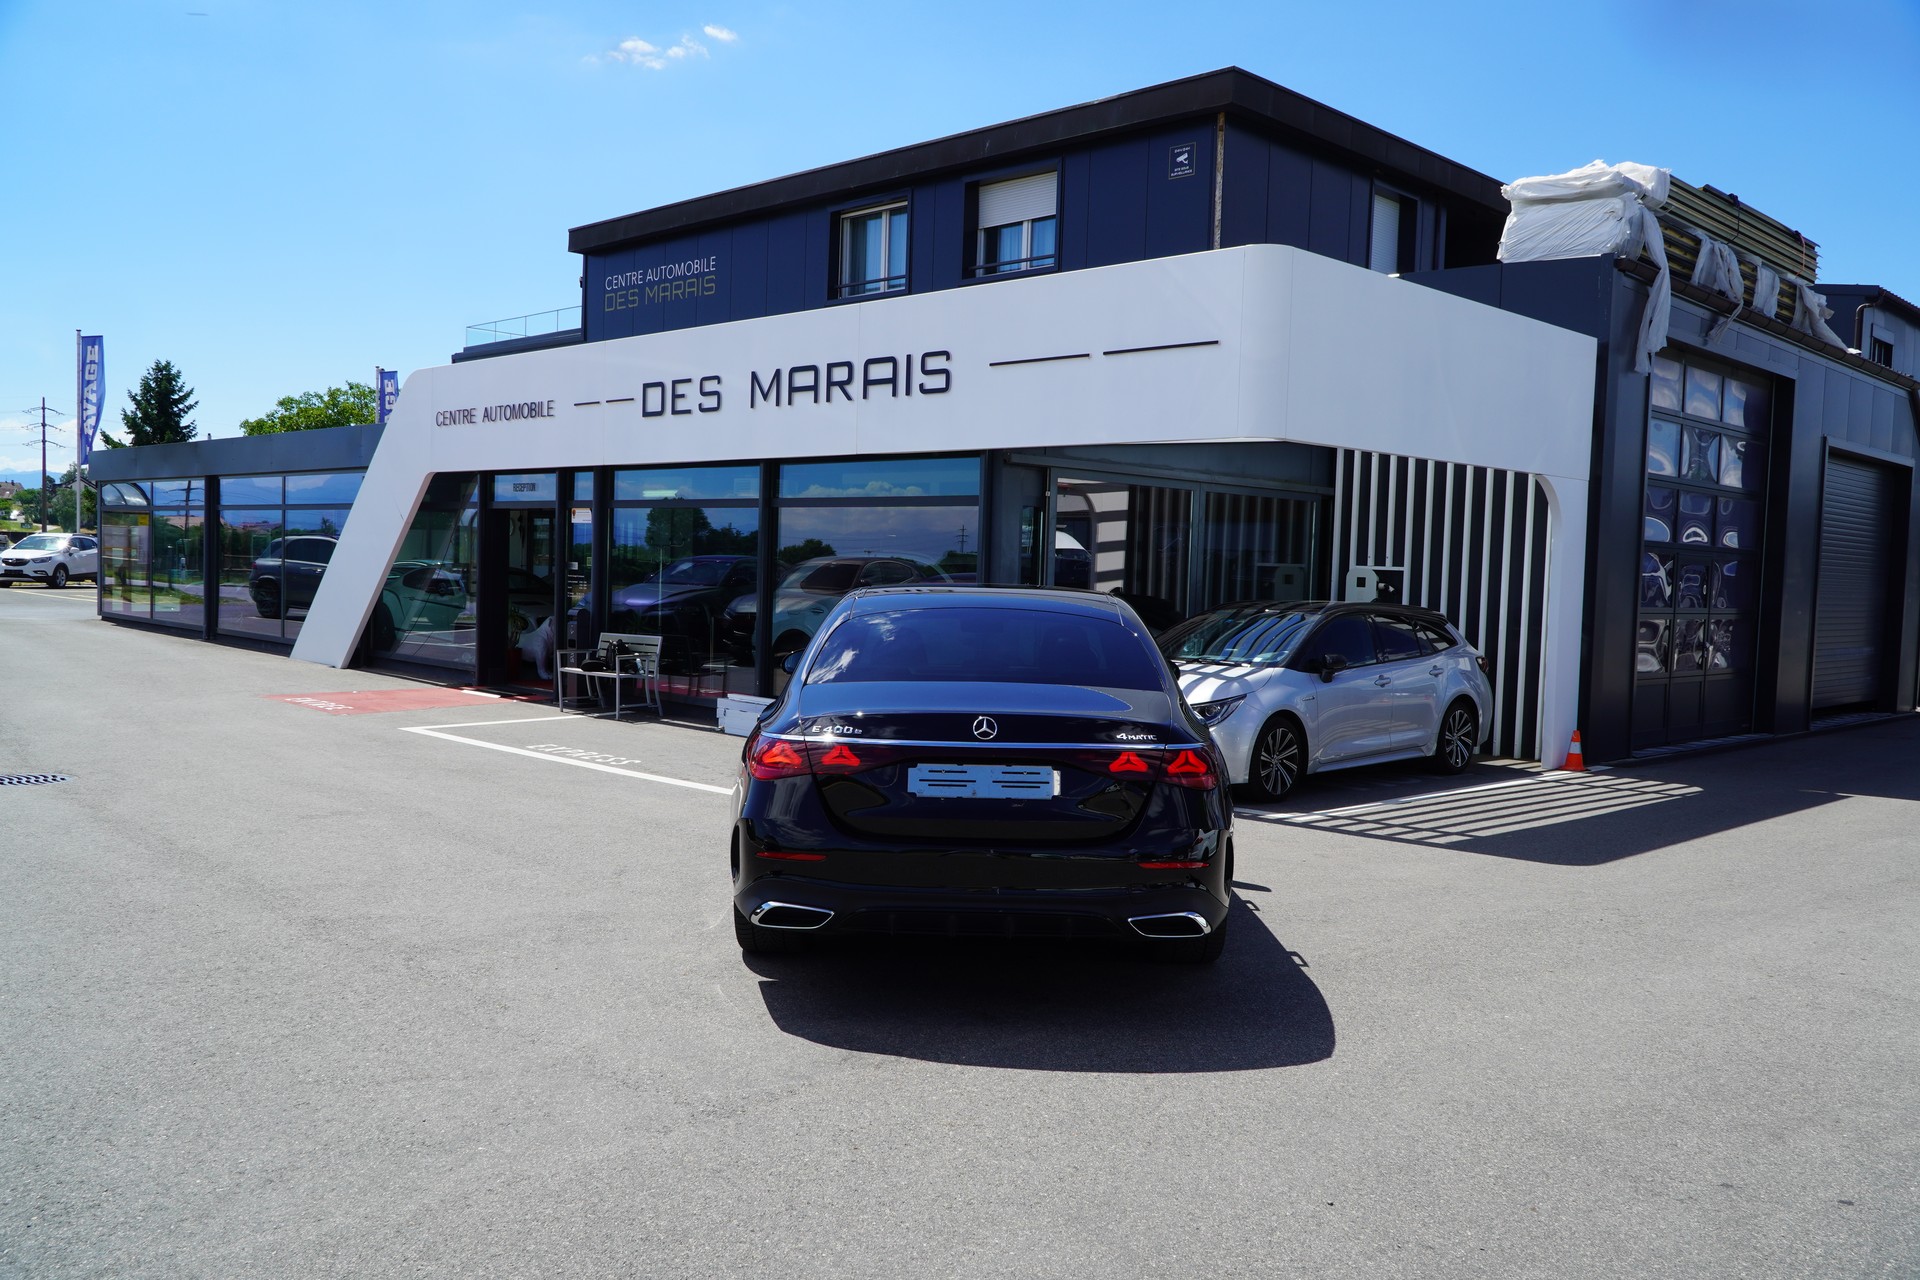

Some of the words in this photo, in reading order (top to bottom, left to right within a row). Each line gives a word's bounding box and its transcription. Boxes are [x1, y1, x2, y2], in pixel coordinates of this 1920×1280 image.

[605, 270, 643, 290] CENTRE
[645, 256, 716, 282] AUTOMOBILE
[605, 288, 639, 312] DES
[645, 275, 716, 304] MARAIS
[436, 408, 476, 426] CENTRE
[482, 400, 554, 422] AUTOMOBILE
[642, 375, 721, 418] DES
[750, 350, 951, 409] MARAIS
[513, 483, 536, 492] RECEPTION
[811, 725, 821, 733] E
[1116, 733, 1158, 741] 4MATIC
[525, 743, 642, 765] EXPRESS
